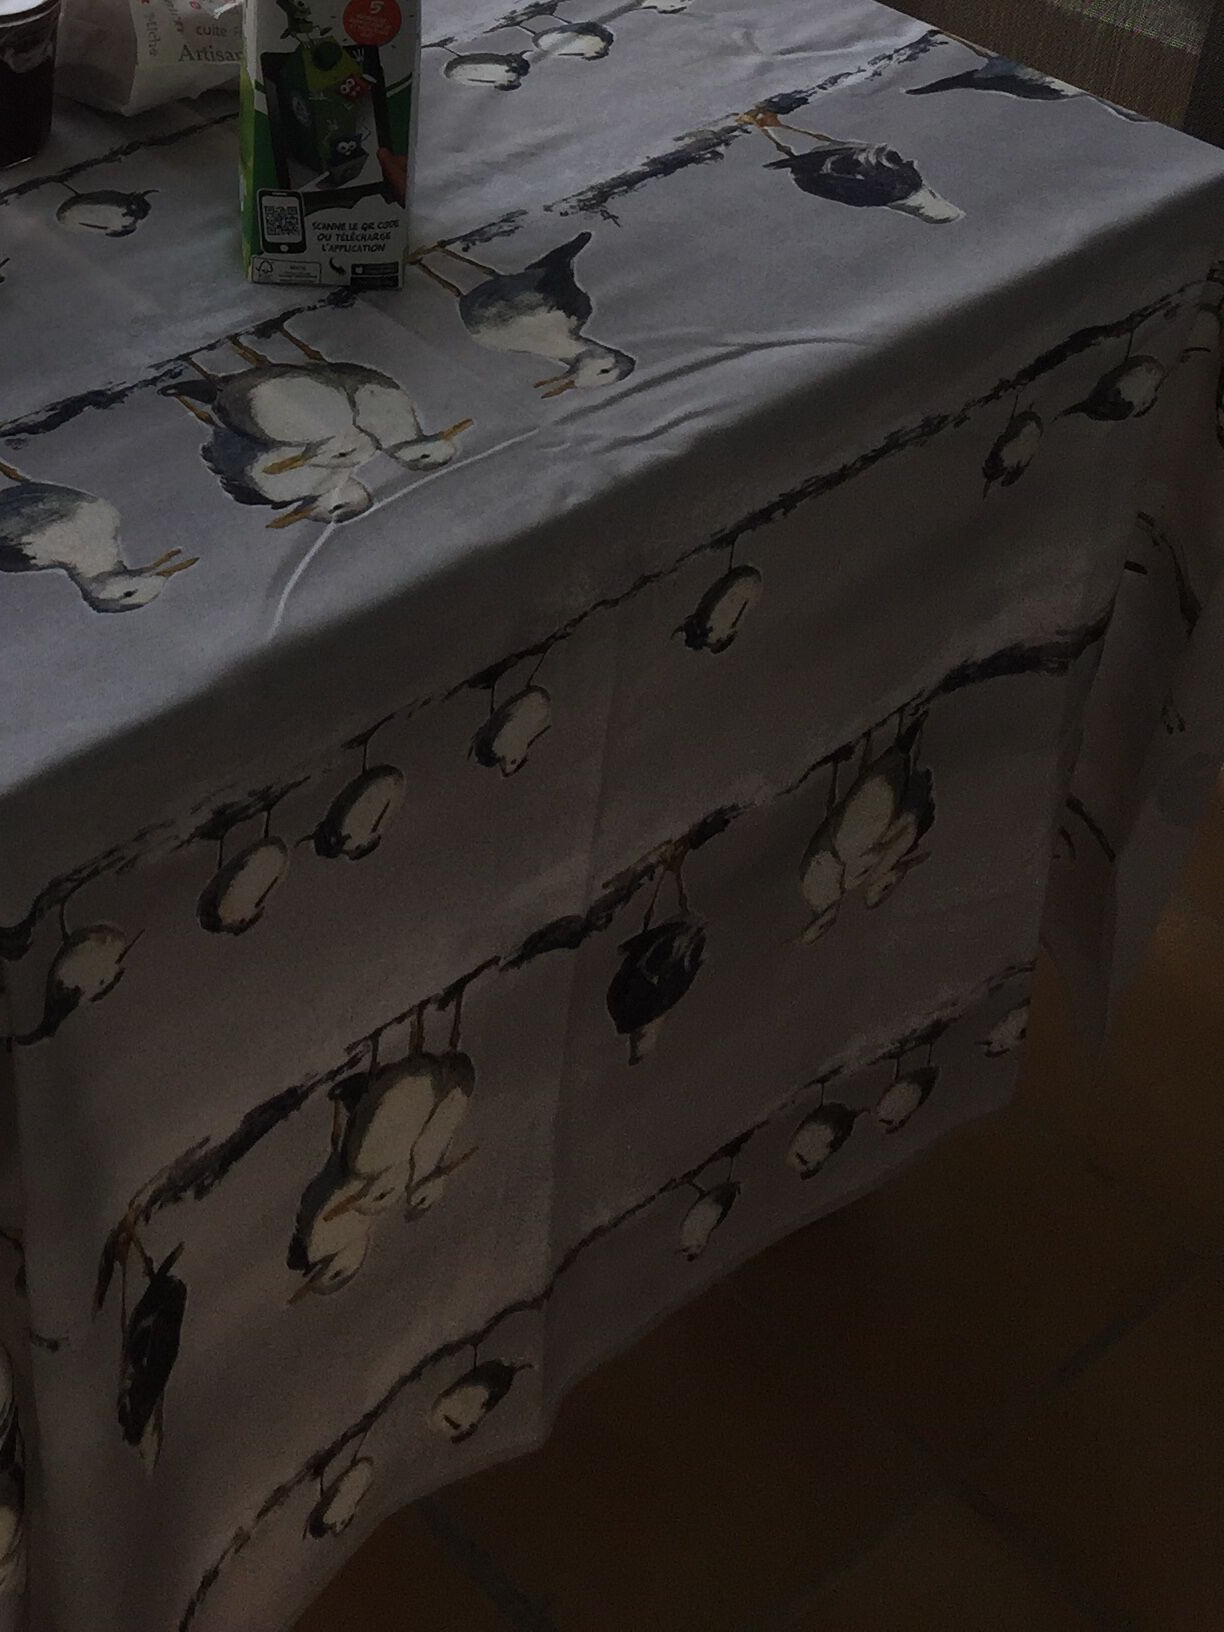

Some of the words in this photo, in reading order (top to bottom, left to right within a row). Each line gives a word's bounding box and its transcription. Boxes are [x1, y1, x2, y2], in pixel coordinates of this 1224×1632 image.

[370, 0, 385, 14] 5
[312, 221, 346, 231] SCANNE
[348, 221, 358, 231] LE
[361, 220, 375, 231] QR
[377, 219, 401, 230] CODE
[317, 233, 332, 242] OU
[335, 231, 392, 242] TÉLÉCHARGE
[321, 242, 386, 253] L'APPLICATION
